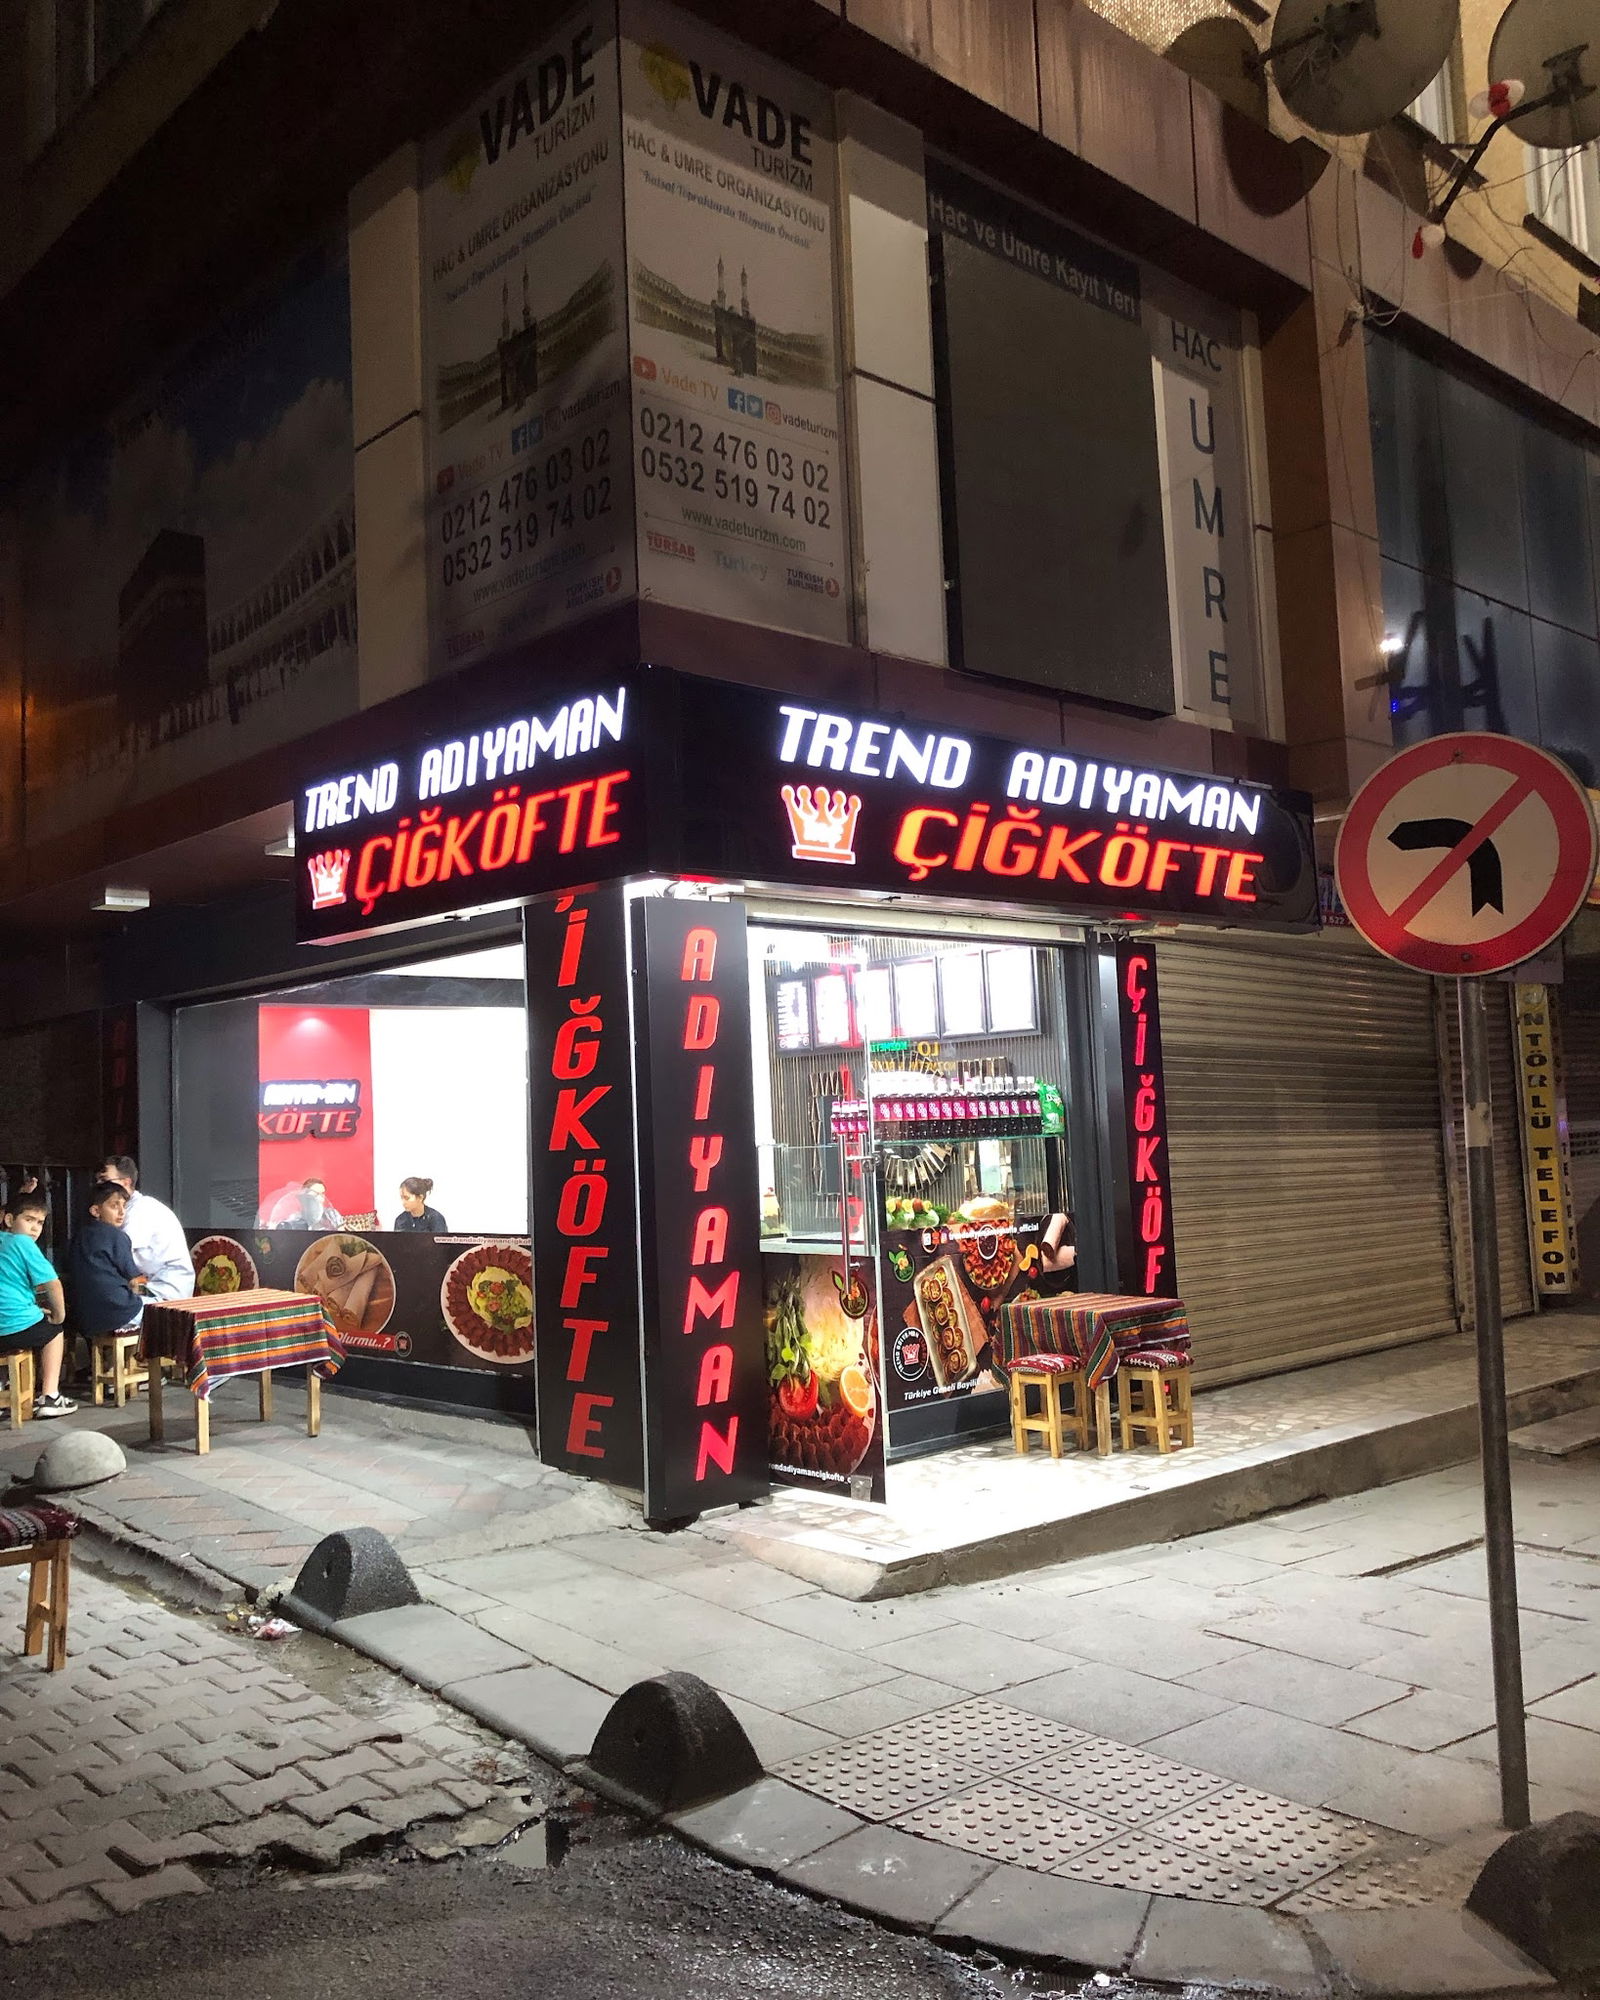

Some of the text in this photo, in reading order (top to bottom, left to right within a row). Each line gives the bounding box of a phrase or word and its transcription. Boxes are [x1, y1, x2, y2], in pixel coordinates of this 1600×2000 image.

[480, 26, 594, 165] VADE
[689, 60, 812, 166] VADE
[627, 129, 656, 157] HAC
[660, 145, 671, 164] &
[674, 149, 713, 184] UMRE
[929, 193, 968, 234] Hac
[973, 218, 996, 248] ve
[1002, 231, 1051, 276] Umre
[661, 367, 719, 401] Vade TV
[1170, 319, 1222, 373] HAC
[640, 408, 830, 493] 0212 476 03 02
[782, 413, 838, 440] vadeturizm
[442, 428, 611, 544] 0212 476 03 02
[443, 475, 612, 587] 0532 519 74 02
[641, 446, 831, 530] 0532 519 74 02
[681, 506, 806, 552] www.vadeturizm.com
[1188, 397, 1232, 707] UMRE
[305, 686, 626, 834] TREND ADIYAMAN
[778, 705, 1262, 836] TREND ADIYAMAN
[354, 769, 632, 916] ÇİĞKÖFTE
[893, 802, 1265, 903] ÇİĞKÖFTE
[547, 896, 615, 1459] İĞKÖFTE
[680, 925, 741, 1482] ADIYAMAN
[1533, 1147, 1566, 1286] TELEFON
[904, 1386, 932, 1401] Türkiye
